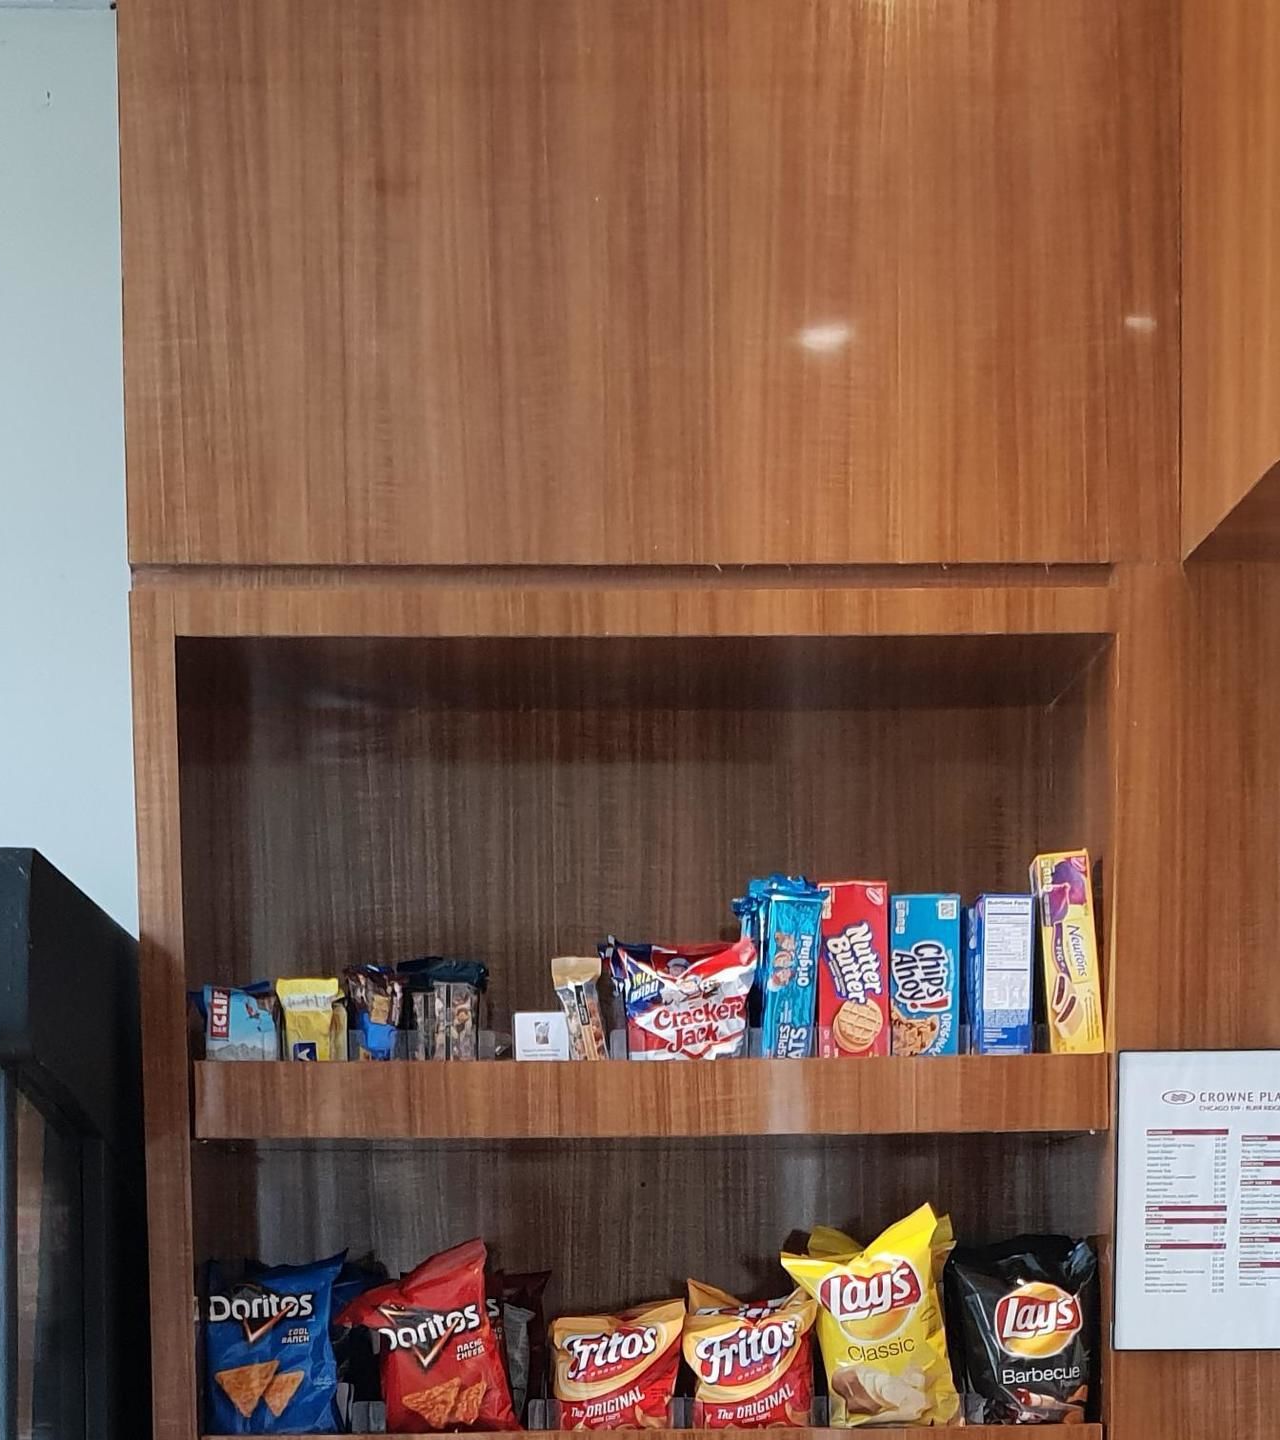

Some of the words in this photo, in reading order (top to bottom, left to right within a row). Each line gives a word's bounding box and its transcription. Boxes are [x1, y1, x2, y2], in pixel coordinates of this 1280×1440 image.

[826, 937, 867, 1003] Butter
[845, 921, 883, 997] Nutter
[913, 943, 946, 1002] Chips
[653, 1000, 746, 1030] Cracker
[668, 1023, 721, 1053] Jack
[1199, 1092, 1254, 1102] CROWNE
[208, 1293, 313, 1322] Doritos
[829, 1262, 912, 1321] Lay's
[1002, 1297, 1075, 1339] Lay's
[561, 1326, 658, 1379] Fritos
[695, 1319, 796, 1384] Fritos
[847, 1336, 915, 1363] Classic
[1002, 1365, 1080, 1385] Barbecue
[586, 1385, 646, 1418] ORIGINAL
[717, 1408, 733, 1420] The
[736, 1383, 794, 1419] ORIGINAL
